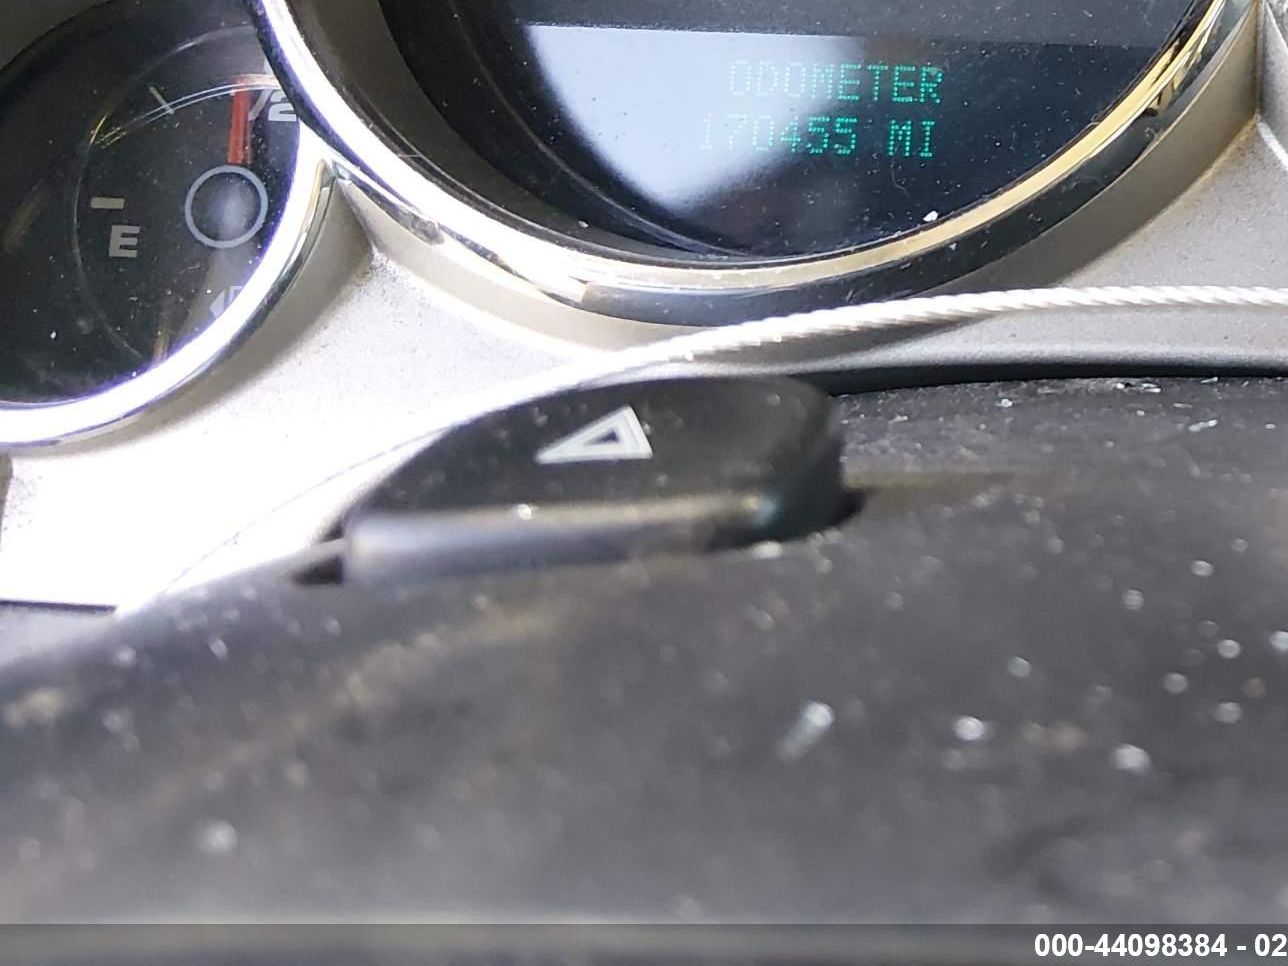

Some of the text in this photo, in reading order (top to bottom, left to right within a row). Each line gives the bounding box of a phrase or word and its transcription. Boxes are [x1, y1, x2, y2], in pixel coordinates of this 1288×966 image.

[728, 59, 945, 105] ODOMETER
[700, 112, 937, 159] 170455 MI
[109, 224, 141, 258] E
